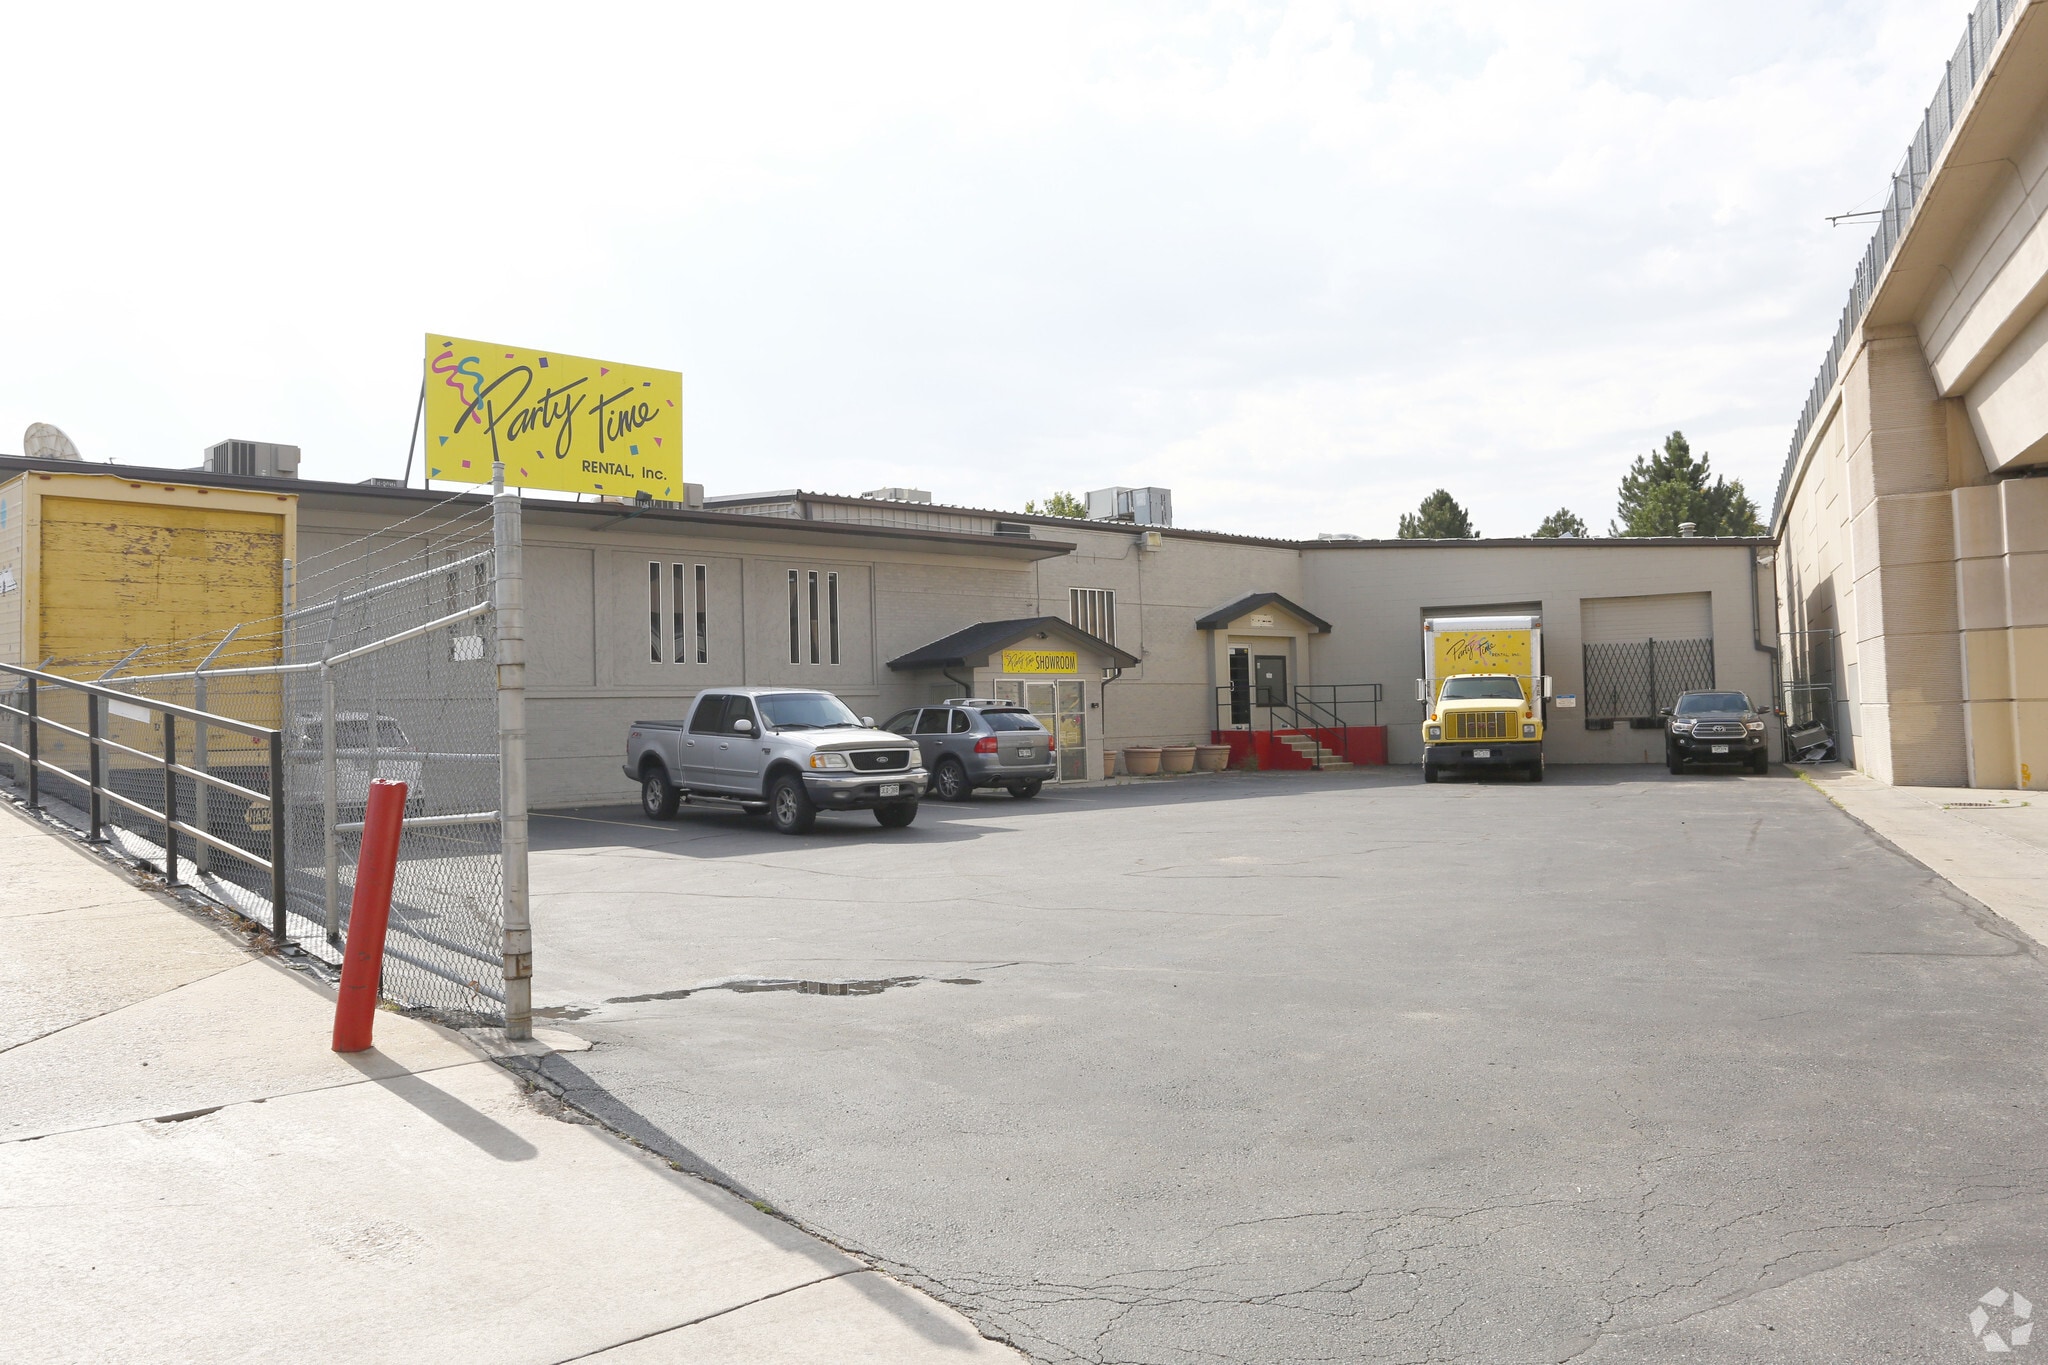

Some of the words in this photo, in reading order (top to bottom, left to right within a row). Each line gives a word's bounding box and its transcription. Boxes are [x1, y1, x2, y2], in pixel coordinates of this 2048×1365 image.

[454, 366, 588, 462] Party
[589, 387, 660, 453] Time
[582, 460, 634, 478] RENTAL,
[642, 467, 667, 480] Inc.
[1447, 639, 1475, 661] Party
[1477, 640, 1496, 657] Time
[1035, 655, 1076, 670] SHOWROOM
